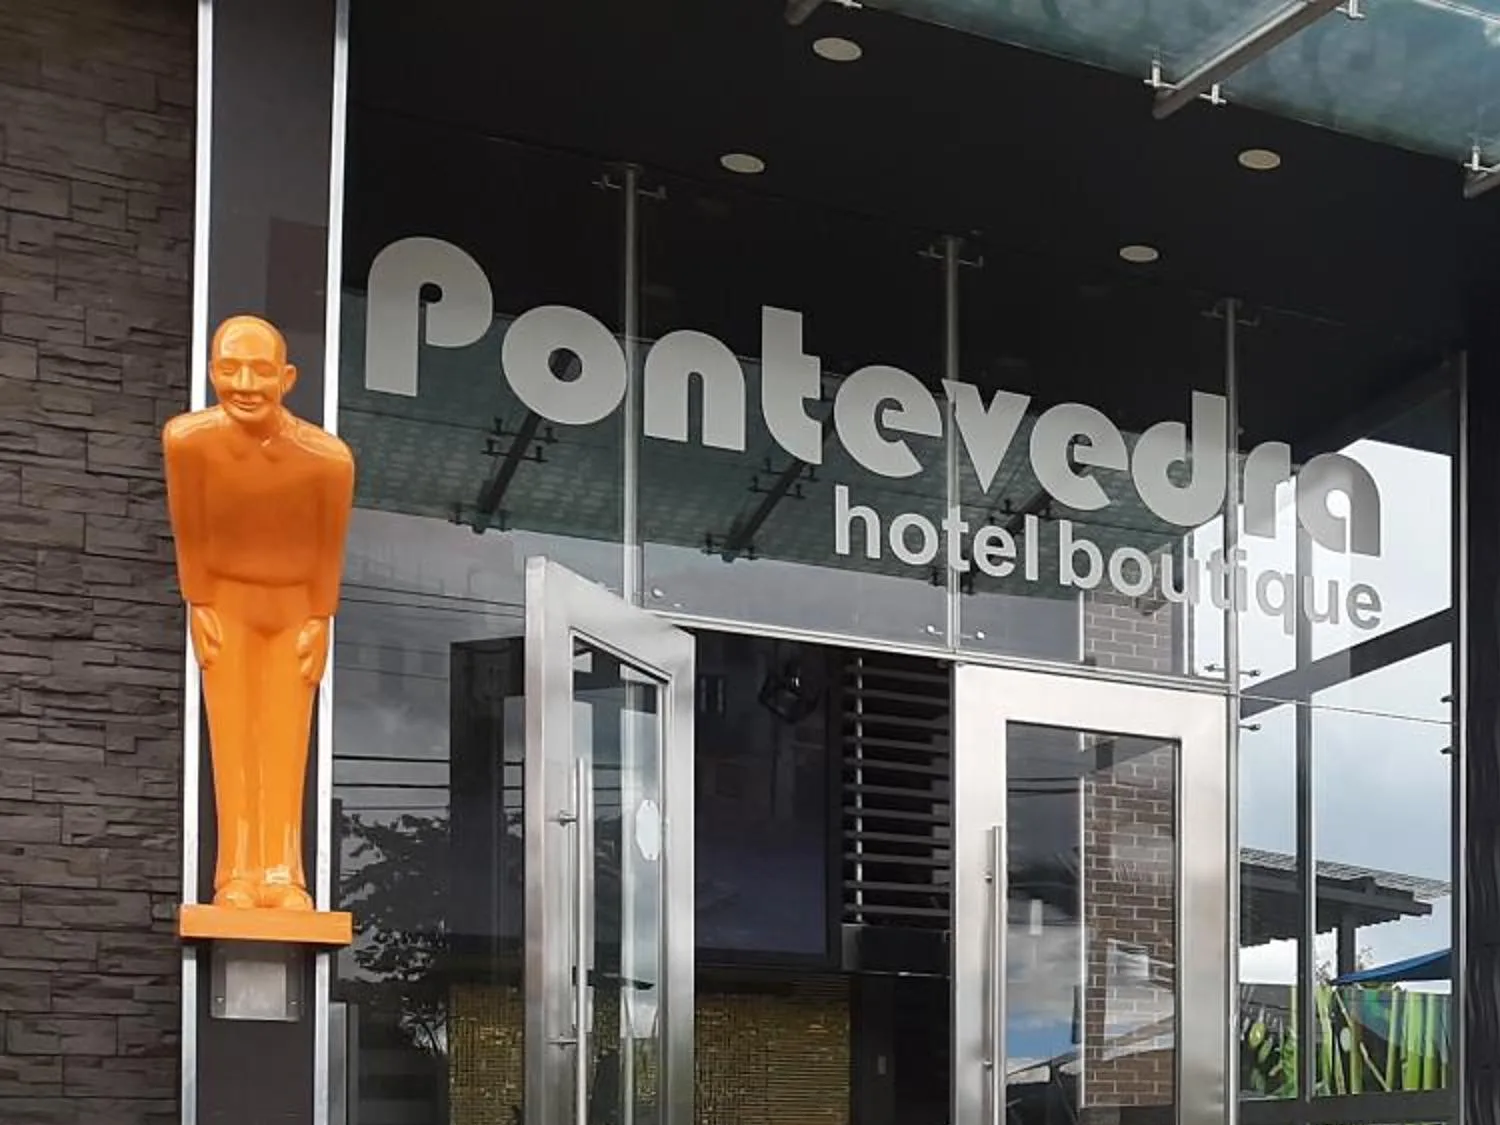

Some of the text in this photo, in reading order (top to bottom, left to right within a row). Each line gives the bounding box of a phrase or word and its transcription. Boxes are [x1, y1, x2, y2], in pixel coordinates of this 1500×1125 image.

[364, 236, 1382, 558] Pontevedra
[834, 485, 1383, 635] hotel boutique
